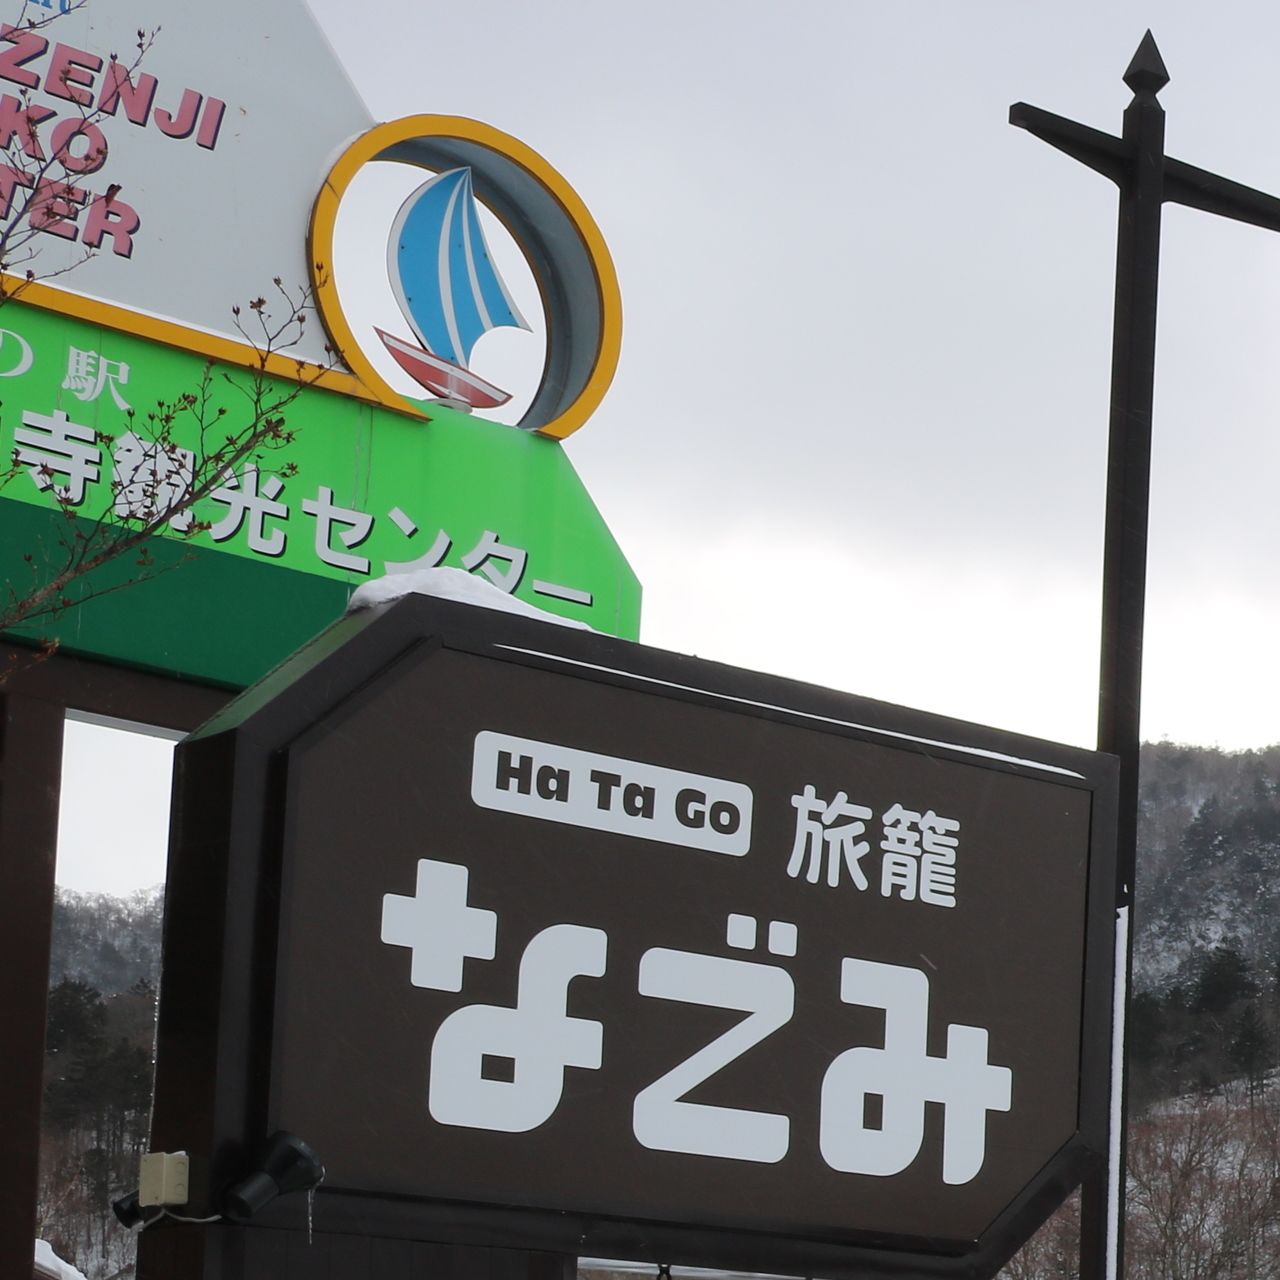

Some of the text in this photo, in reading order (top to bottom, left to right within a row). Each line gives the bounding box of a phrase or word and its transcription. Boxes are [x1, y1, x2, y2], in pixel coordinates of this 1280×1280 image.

[0, 23, 226, 151] ZENJI
[496, 750, 570, 802] Ha
[590, 769, 655, 819] Ta
[787, 784, 960, 908] 旅籠
[381, 858, 1013, 1185] なごみ
